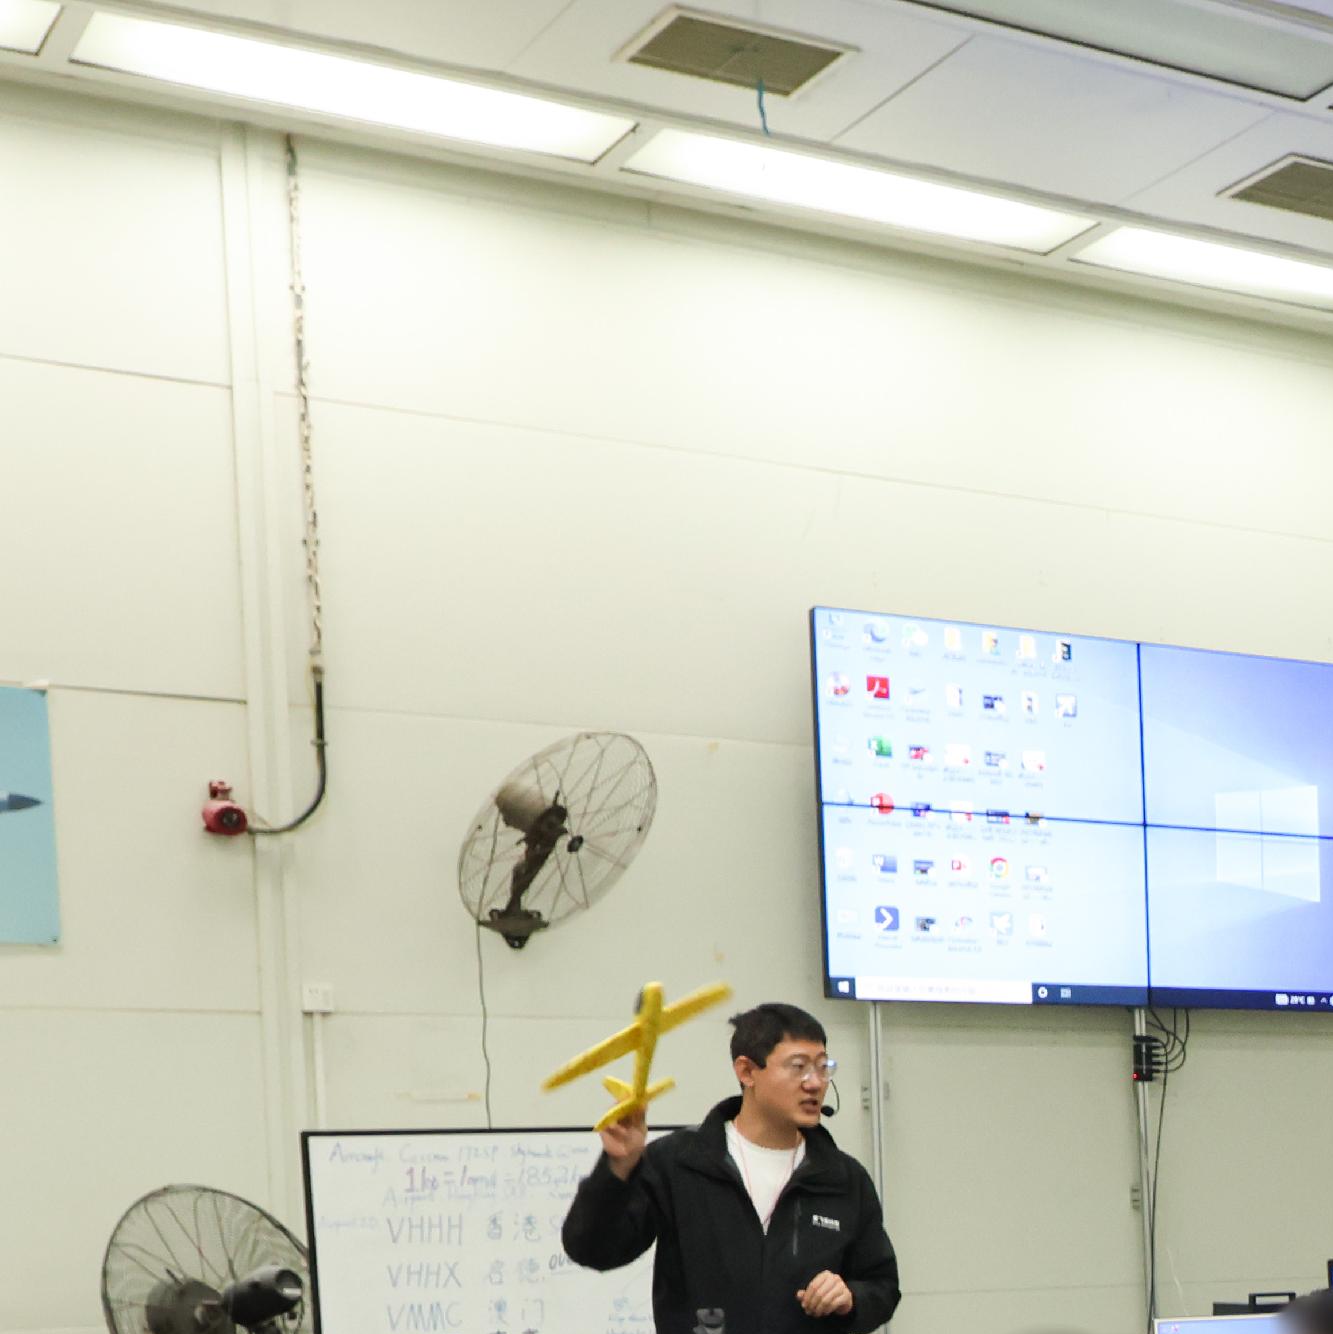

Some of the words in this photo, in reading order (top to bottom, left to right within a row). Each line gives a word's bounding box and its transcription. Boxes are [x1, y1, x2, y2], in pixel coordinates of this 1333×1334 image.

[386, 1213, 463, 1246] VHHH
[387, 1262, 462, 1289] VHHX
[387, 1302, 463, 1332] VMMC
